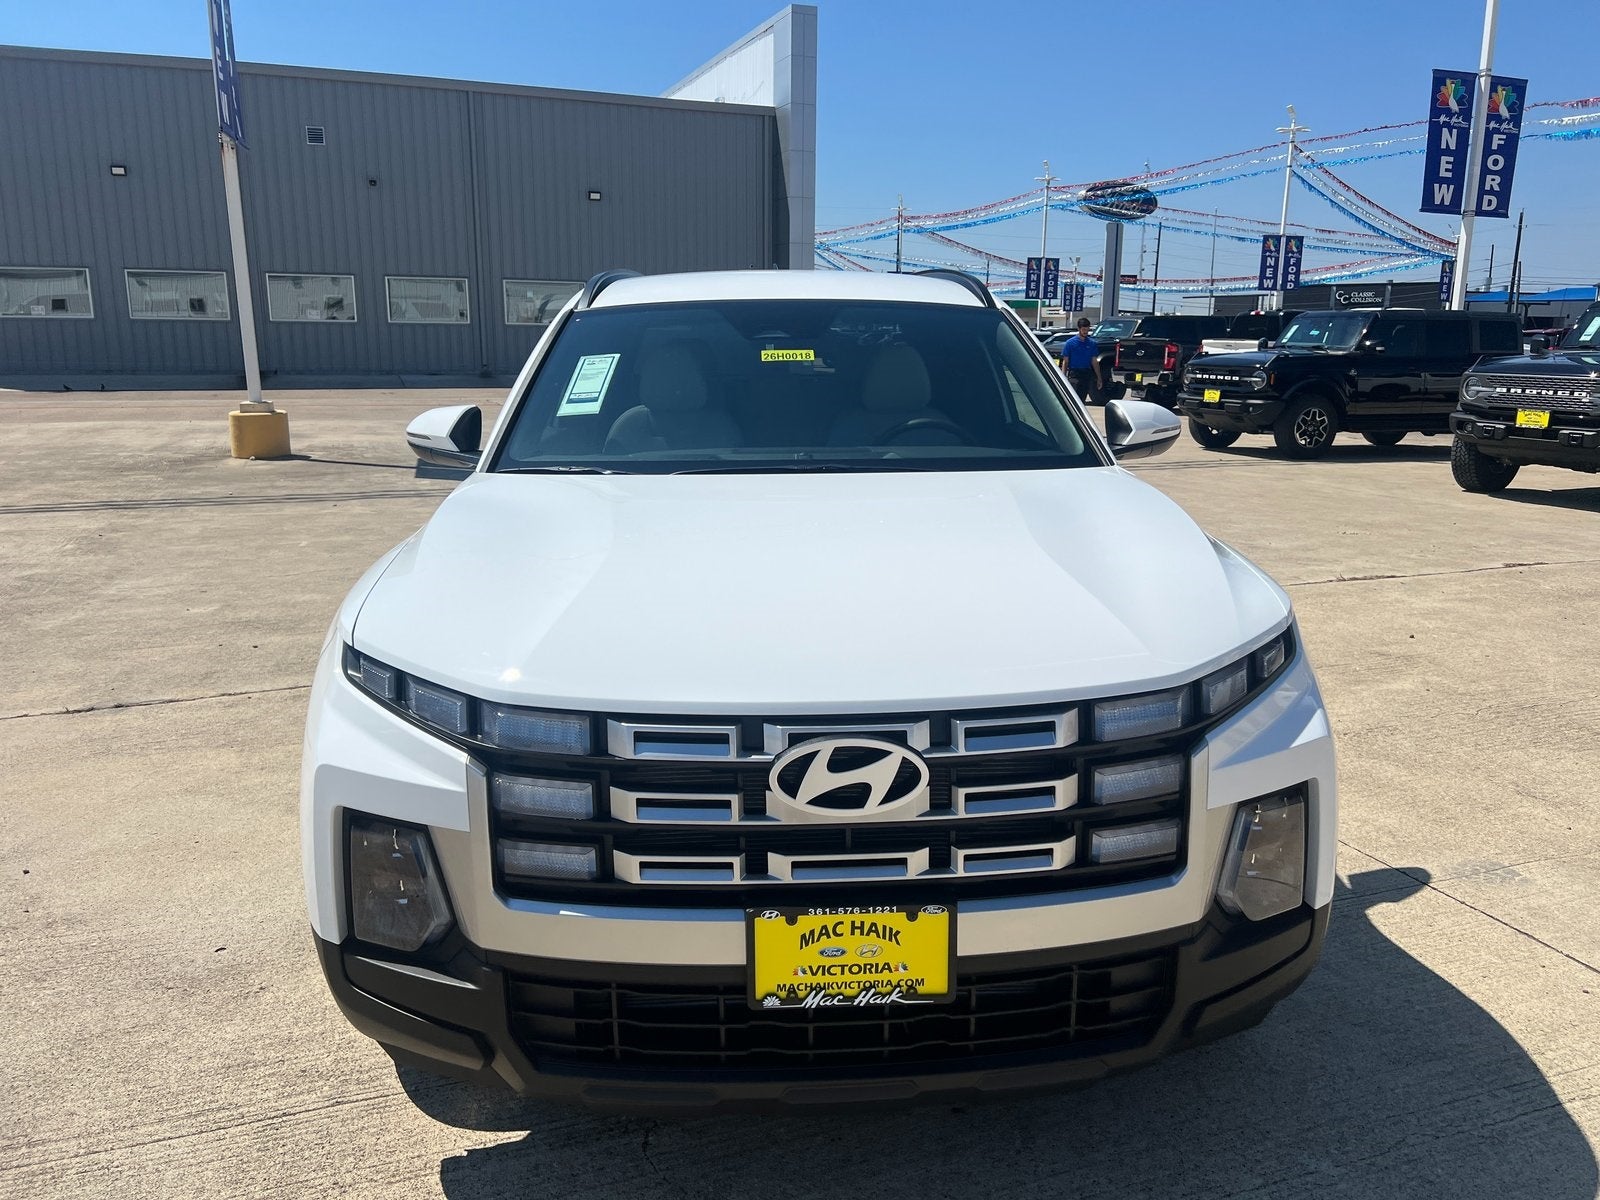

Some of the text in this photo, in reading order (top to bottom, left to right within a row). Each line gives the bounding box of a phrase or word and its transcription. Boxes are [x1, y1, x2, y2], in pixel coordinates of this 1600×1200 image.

[1433, 128, 1457, 205] NEW
[1481, 134, 1507, 211] FORD
[1263, 257, 1275, 288] NEW
[1286, 258, 1297, 289] FORD
[1029, 274, 1037, 297] NEW
[1047, 274, 1055, 298] FORD
[1440, 277, 1449, 300] NEW
[763, 352, 812, 361] 26H0018
[1495, 387, 1587, 397] BRONCO
[808, 906, 897, 916] 361-576-1221
[924, 905, 944, 914] Ford
[800, 920, 901, 951] MAC HAIK
[822, 948, 844, 957] Ford
[808, 962, 893, 977] VICTORIA
[798, 987, 915, 1008] Mac Haik
